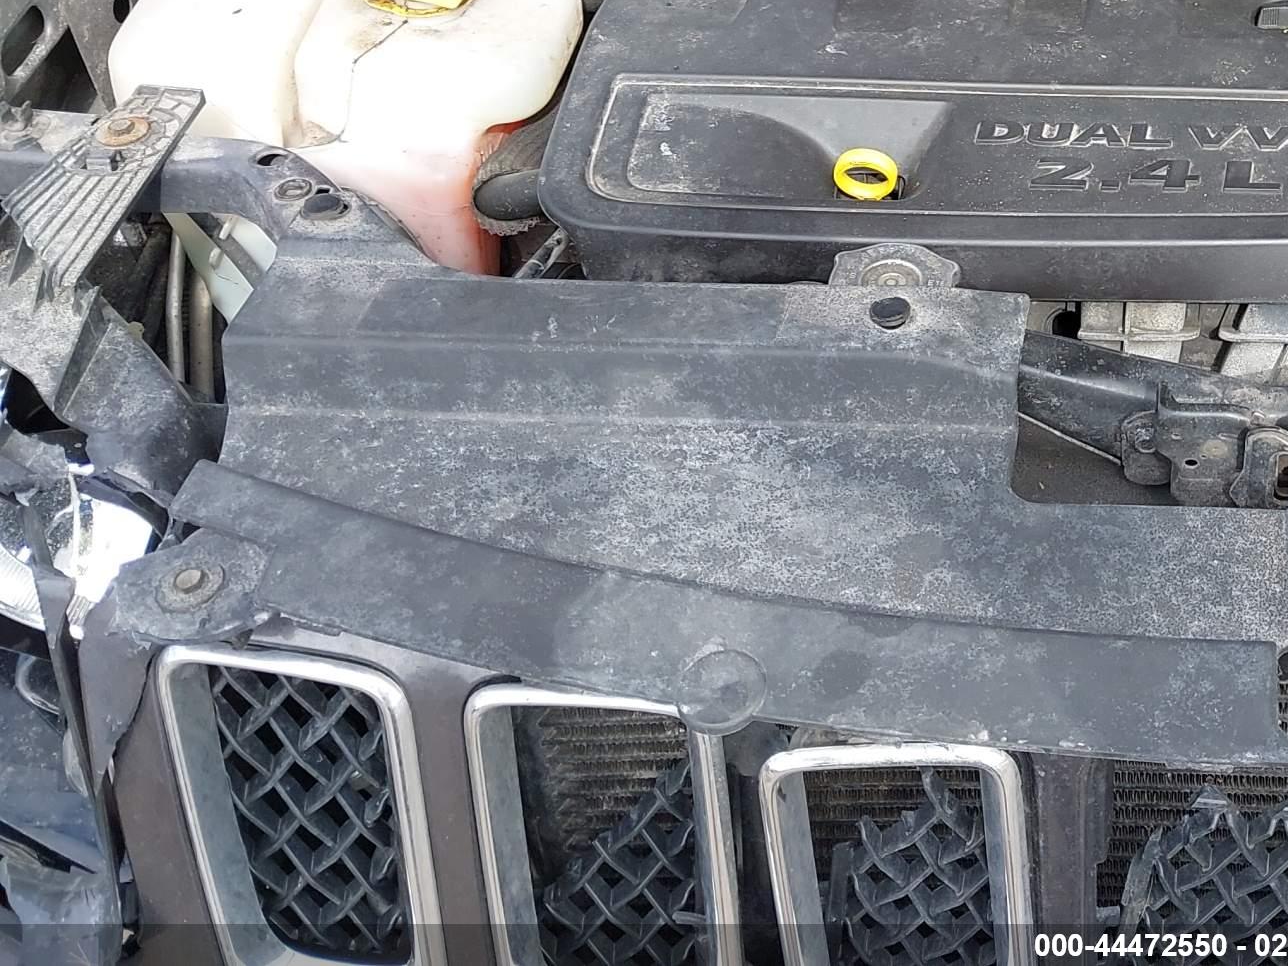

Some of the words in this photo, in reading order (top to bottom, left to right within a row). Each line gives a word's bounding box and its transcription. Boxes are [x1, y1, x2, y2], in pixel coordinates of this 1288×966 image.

[974, 121, 1173, 149] DUAL
[1029, 157, 1200, 193] 2.4
[1221, 159, 1283, 194] L
